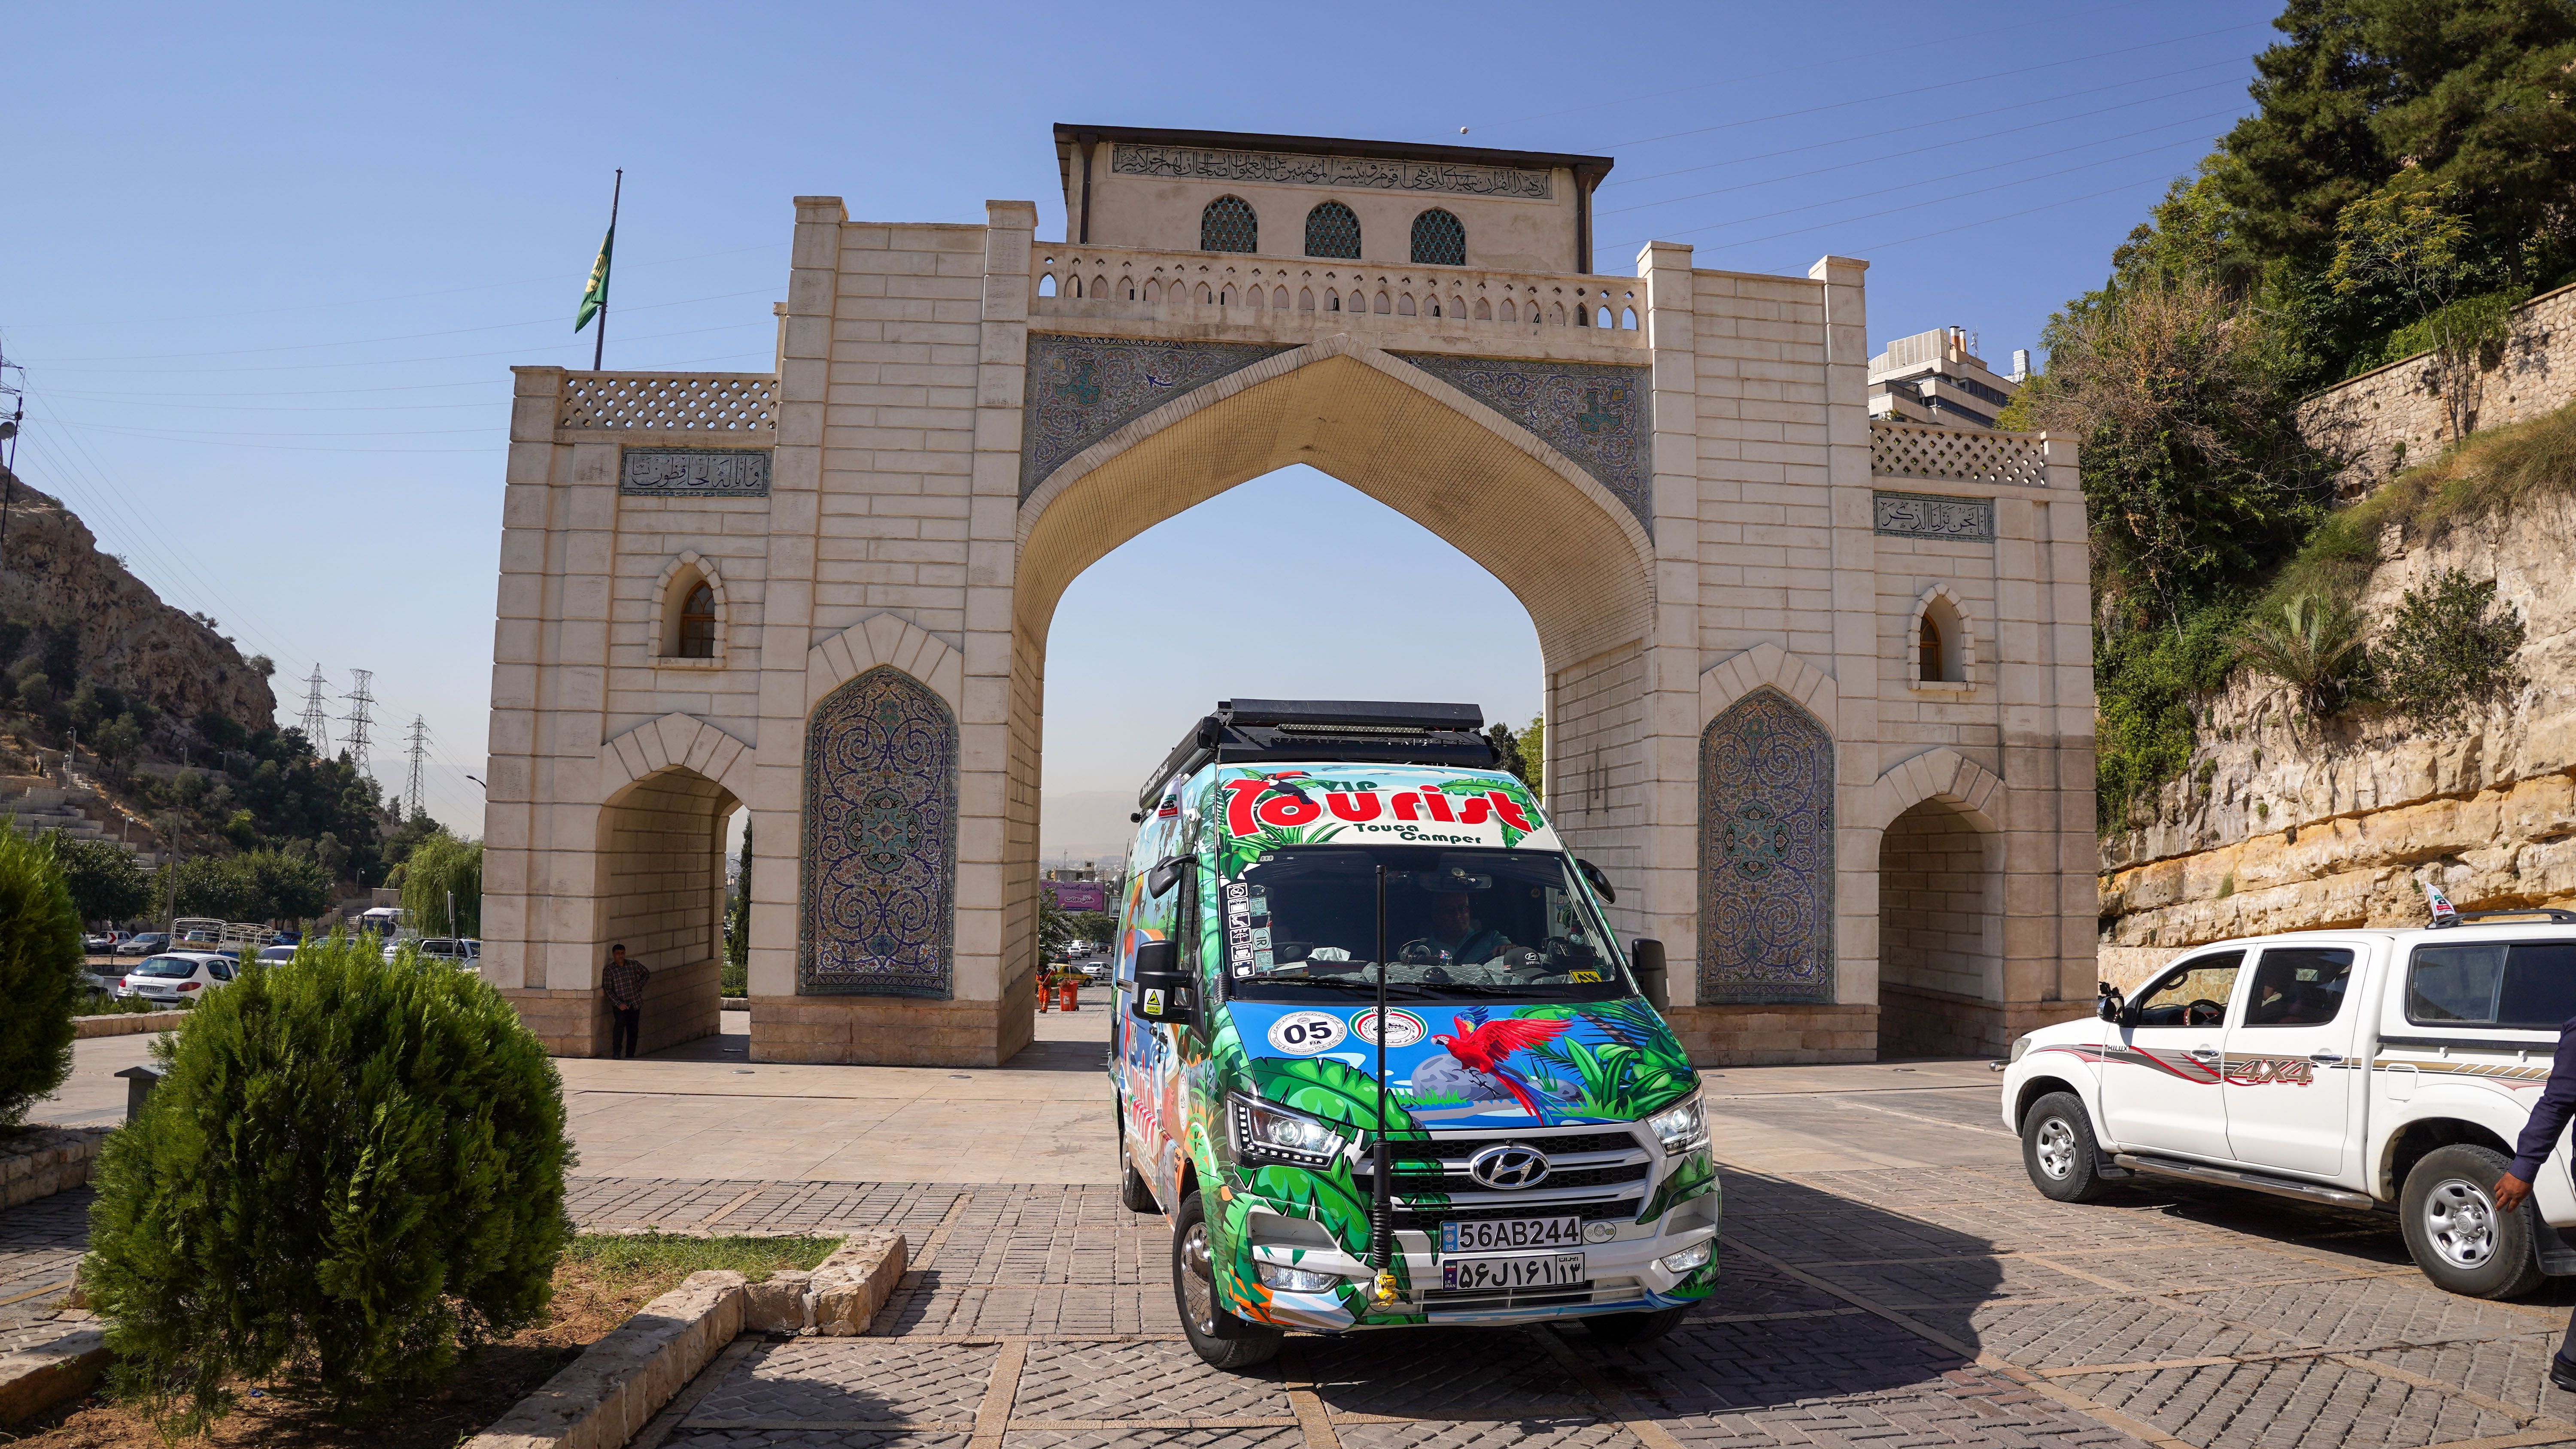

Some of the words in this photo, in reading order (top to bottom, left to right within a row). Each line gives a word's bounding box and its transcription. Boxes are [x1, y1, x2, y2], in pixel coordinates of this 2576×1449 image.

[1318, 781, 1378, 792] VIP
[1222, 778, 1534, 839] Tourist
[1353, 823, 1419, 832] Touca
[1399, 831, 1482, 844] Camper
[1256, 937, 1267, 946] IR
[1284, 1022, 1332, 1043] 05
[1459, 1218, 1579, 1248] 56AB244
[1560, 1263, 1581, 1283] ۱۳
